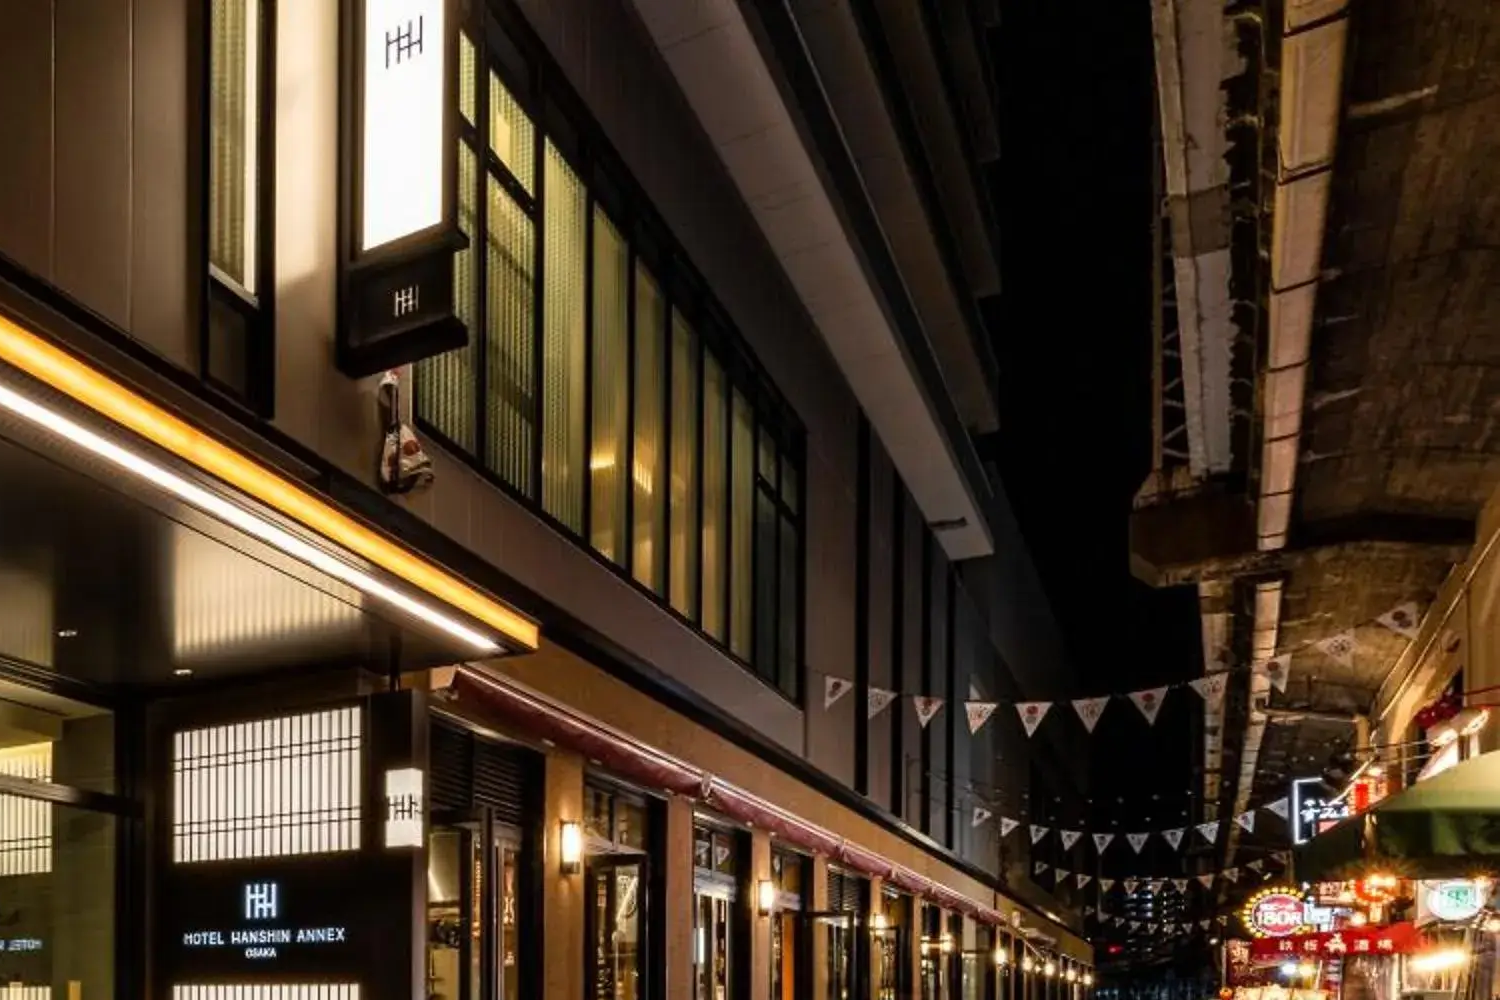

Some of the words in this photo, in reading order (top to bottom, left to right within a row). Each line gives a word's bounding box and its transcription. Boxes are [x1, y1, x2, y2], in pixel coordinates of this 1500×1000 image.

[183, 931, 224, 945] HOTEL
[231, 929, 291, 945] HANSHIN
[297, 927, 346, 944] ANNEX
[245, 948, 277, 959] OSAKA
